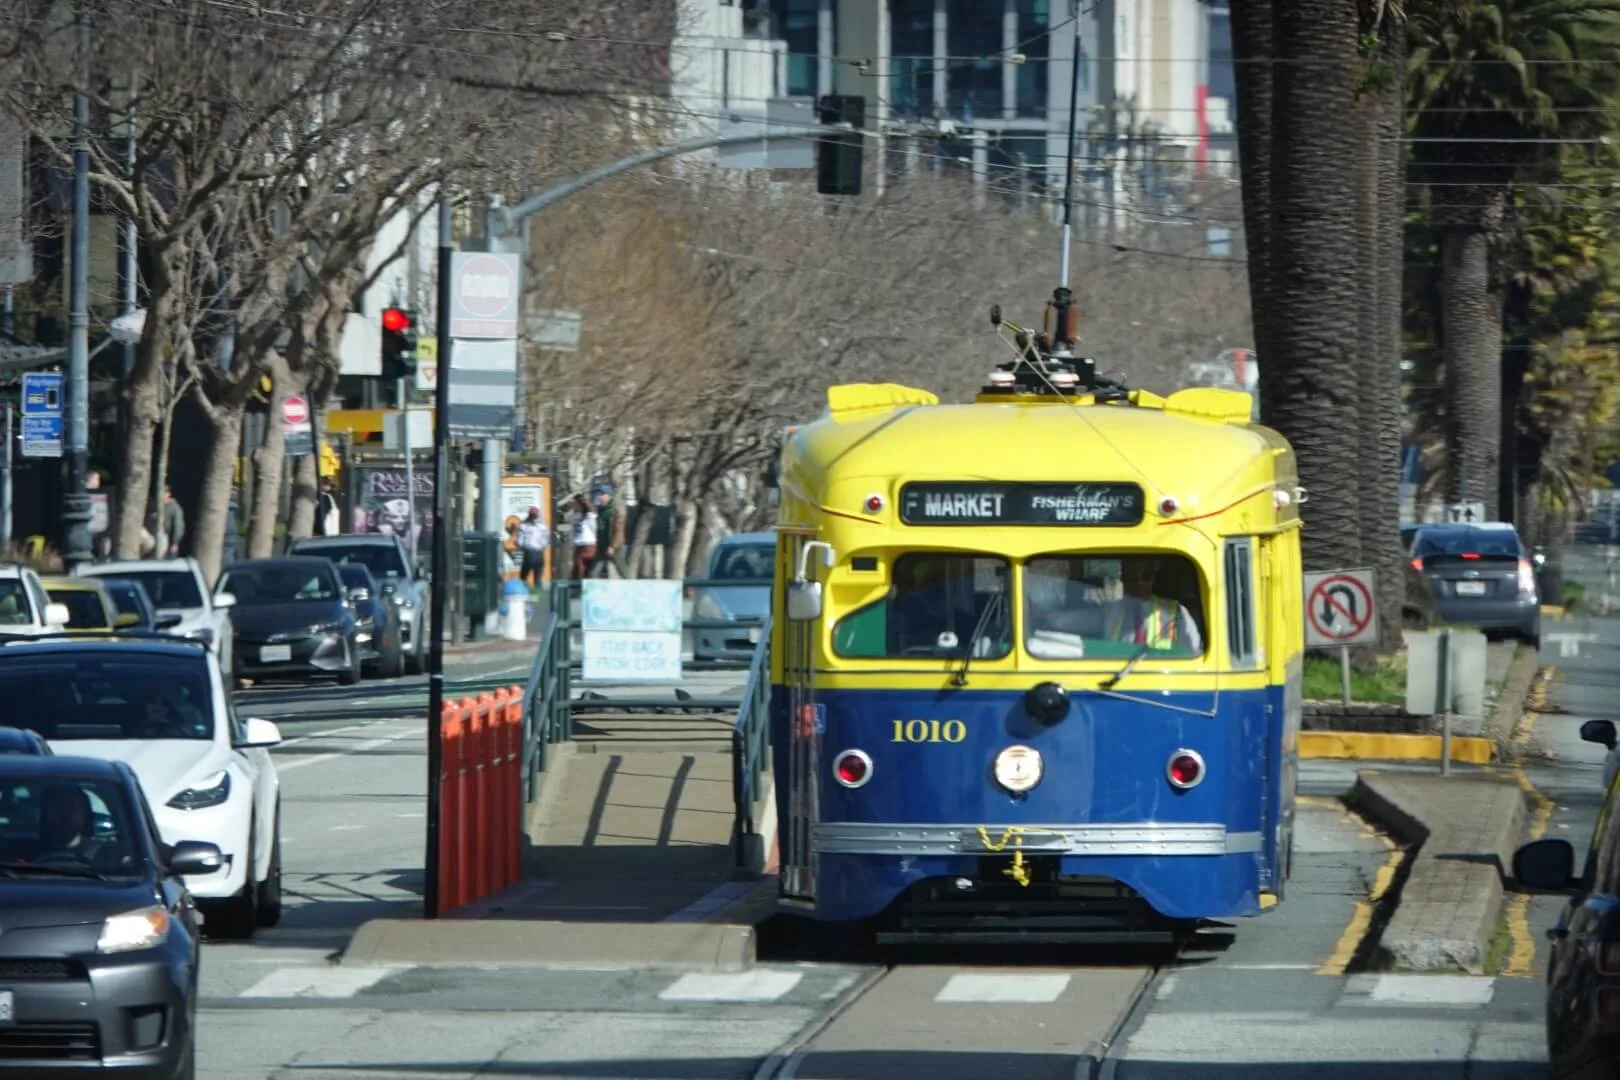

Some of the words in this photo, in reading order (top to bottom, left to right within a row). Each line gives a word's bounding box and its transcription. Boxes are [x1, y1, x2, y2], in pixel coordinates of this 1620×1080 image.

[924, 491, 1005, 517] MARKET
[1030, 495, 1135, 510] FISHERMAN'S
[1055, 508, 1110, 521] WHARF
[889, 718, 967, 743] 1010
